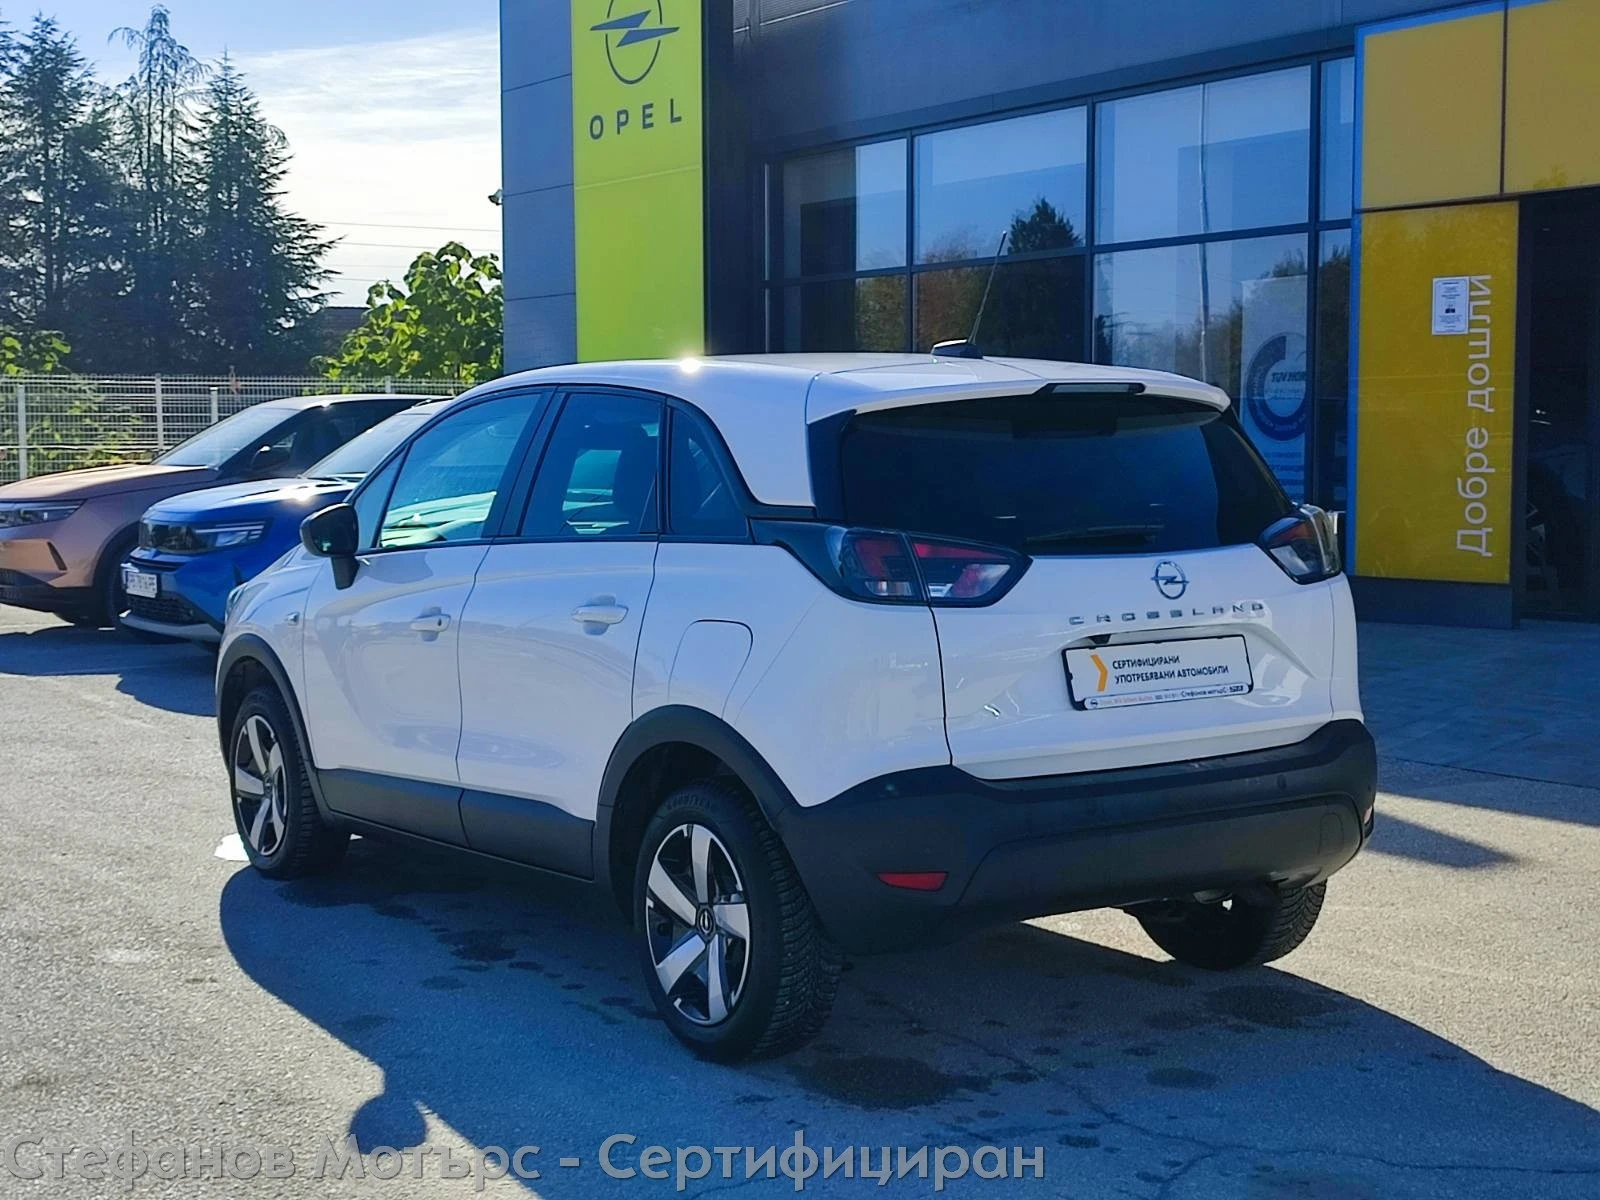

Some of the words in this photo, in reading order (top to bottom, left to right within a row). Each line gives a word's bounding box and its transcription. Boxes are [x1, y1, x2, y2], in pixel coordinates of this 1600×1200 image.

[589, 98, 682, 140] OPEL
[1467, 274, 1495, 412] дошли
[1456, 427, 1495, 557] Добре
[1069, 603, 1264, 626] CROSSLAND
[1112, 655, 1180, 670] СЕРТИФИЦИРАНИ
[1114, 669, 1176, 685] УПОТРЕБЯВАНИ
[1177, 665, 1230, 678] АВТОМОБИЛИ
